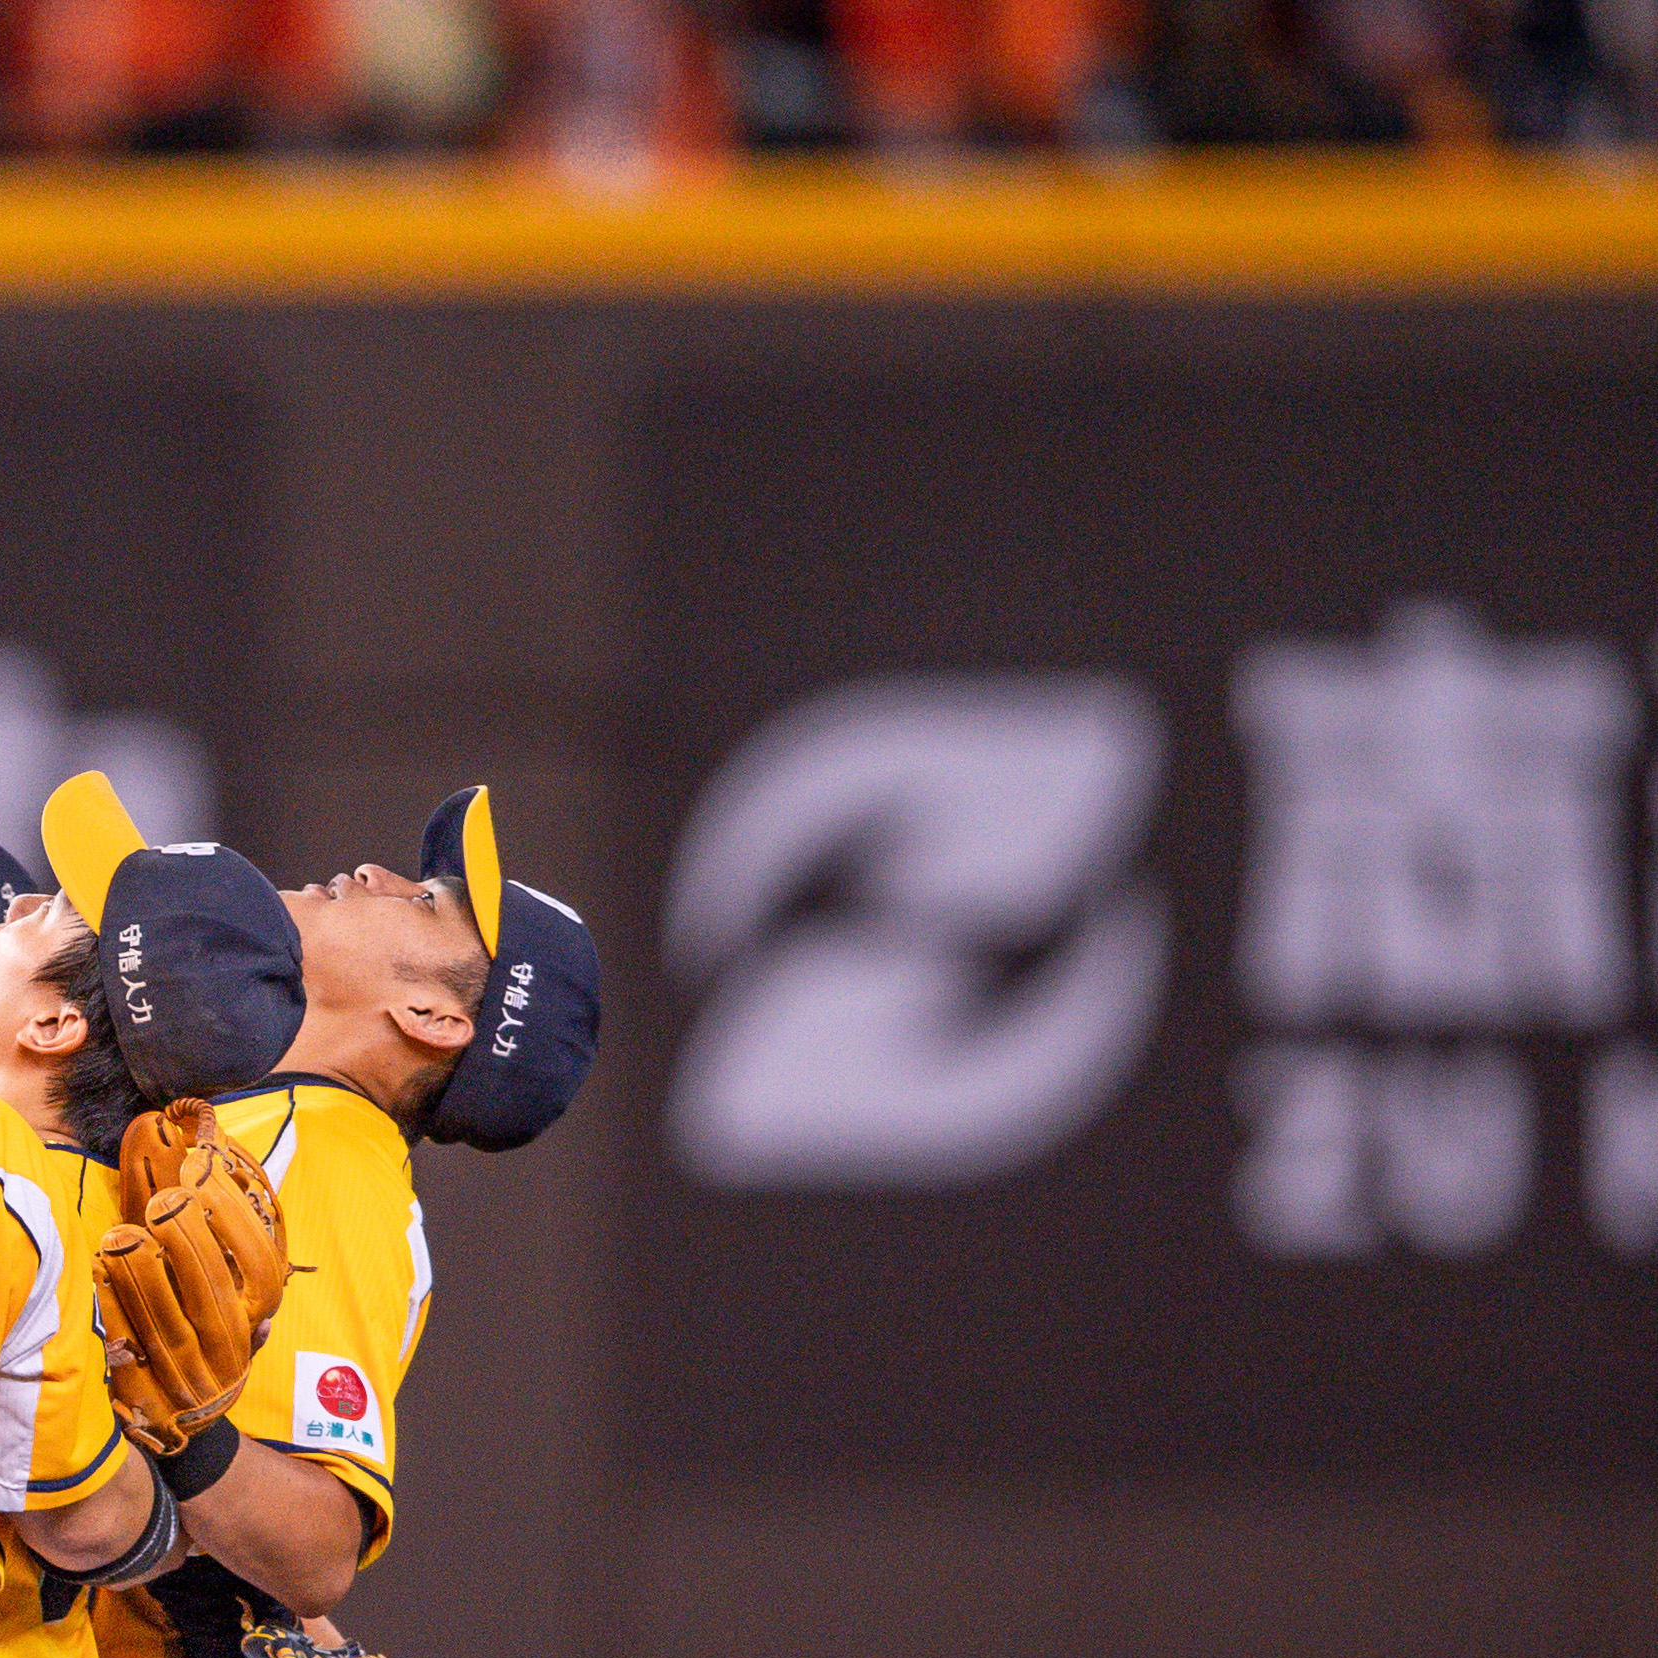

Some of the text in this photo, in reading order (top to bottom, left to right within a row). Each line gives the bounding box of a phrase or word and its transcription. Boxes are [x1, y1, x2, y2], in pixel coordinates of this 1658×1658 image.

[118, 923, 153, 1024] 守信人力
[492, 961, 533, 1057] 守信人力
[306, 1420, 374, 1448] 台灣人壽
